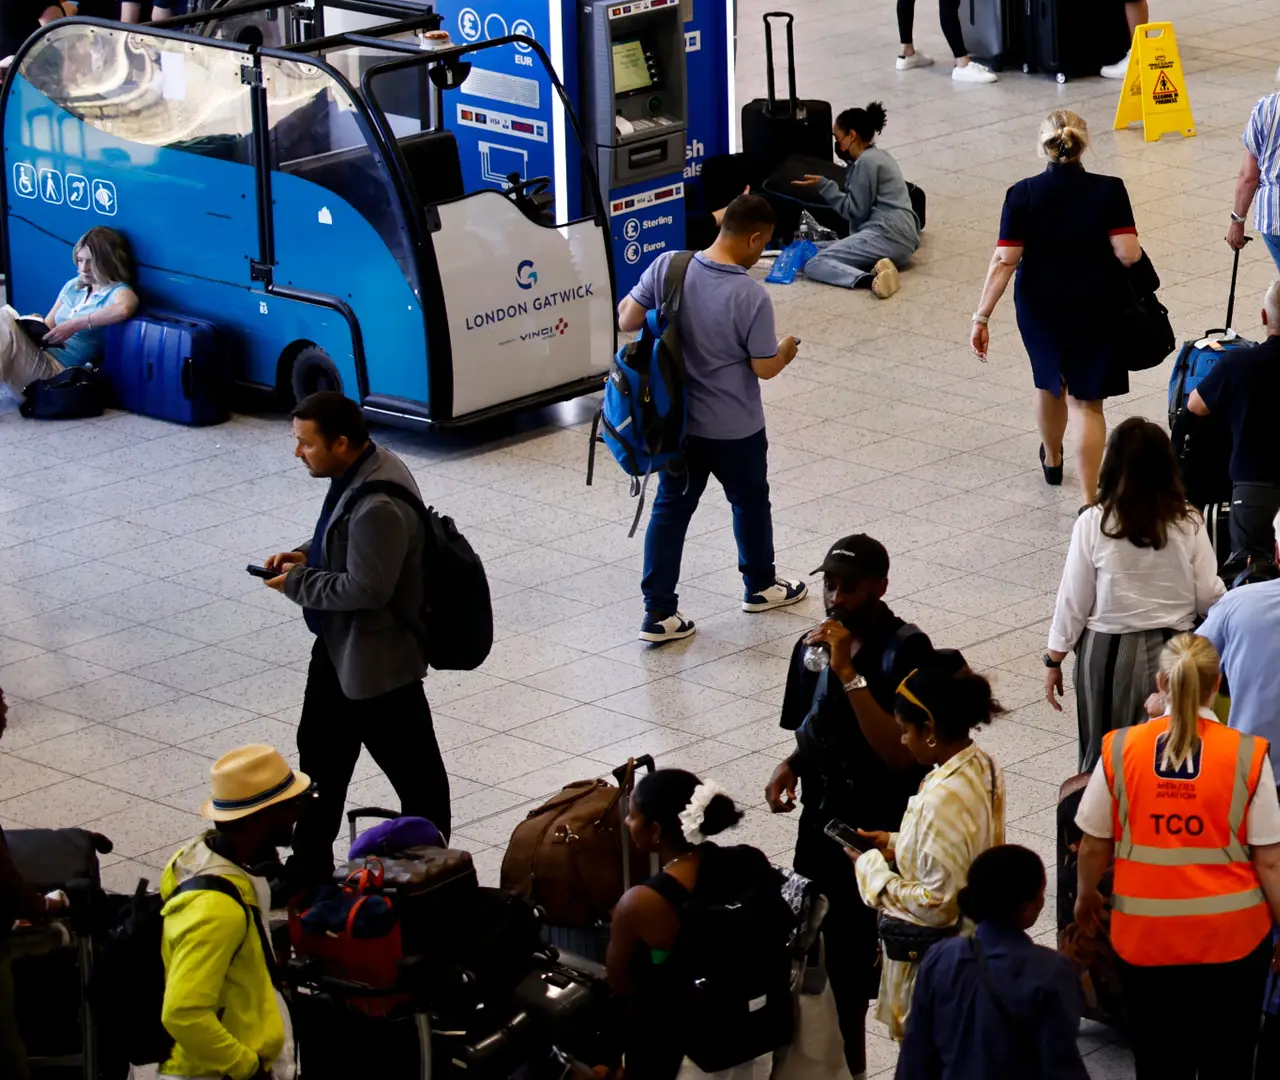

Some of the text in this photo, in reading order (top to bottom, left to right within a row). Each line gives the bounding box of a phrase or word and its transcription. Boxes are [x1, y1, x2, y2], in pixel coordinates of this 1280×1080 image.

[514, 54, 533, 67] EUR
[685, 138, 704, 159] sh
[642, 215, 673, 229] Sterling
[643, 241, 666, 253] Euros
[465, 283, 594, 330] LONDON GATWICK
[519, 326, 553, 341] VINCI
[1150, 813, 1205, 836] TCO
